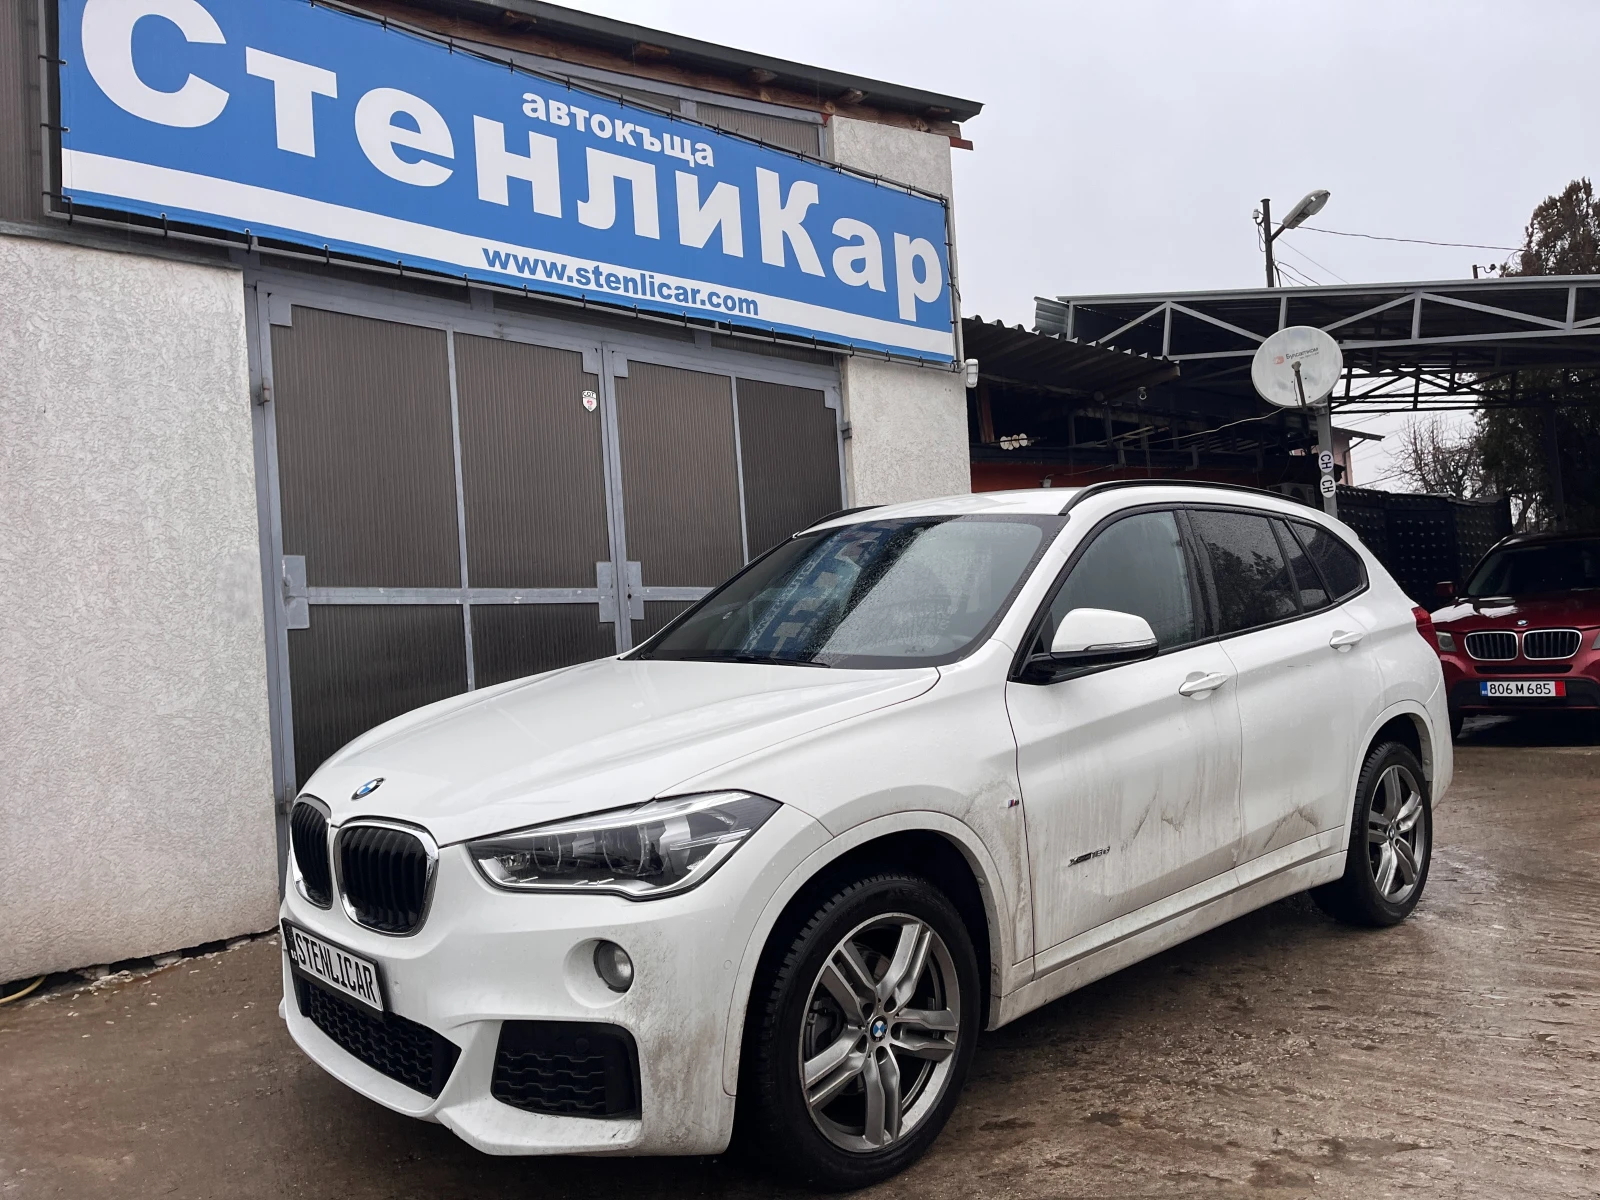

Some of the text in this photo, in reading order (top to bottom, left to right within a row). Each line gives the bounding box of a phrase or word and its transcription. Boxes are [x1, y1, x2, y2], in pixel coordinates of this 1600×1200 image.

[81, 0, 943, 322] СтенлиКар
[522, 92, 714, 168] автокъща
[482, 247, 759, 316] www.stenlicar.com
[1320, 454, 1332, 470] CH
[1322, 480, 1335, 493] CH
[1489, 683, 1513, 695] 806
[1515, 683, 1525, 695] M
[1527, 683, 1552, 695] 685
[295, 932, 377, 1004] STENLICAR
